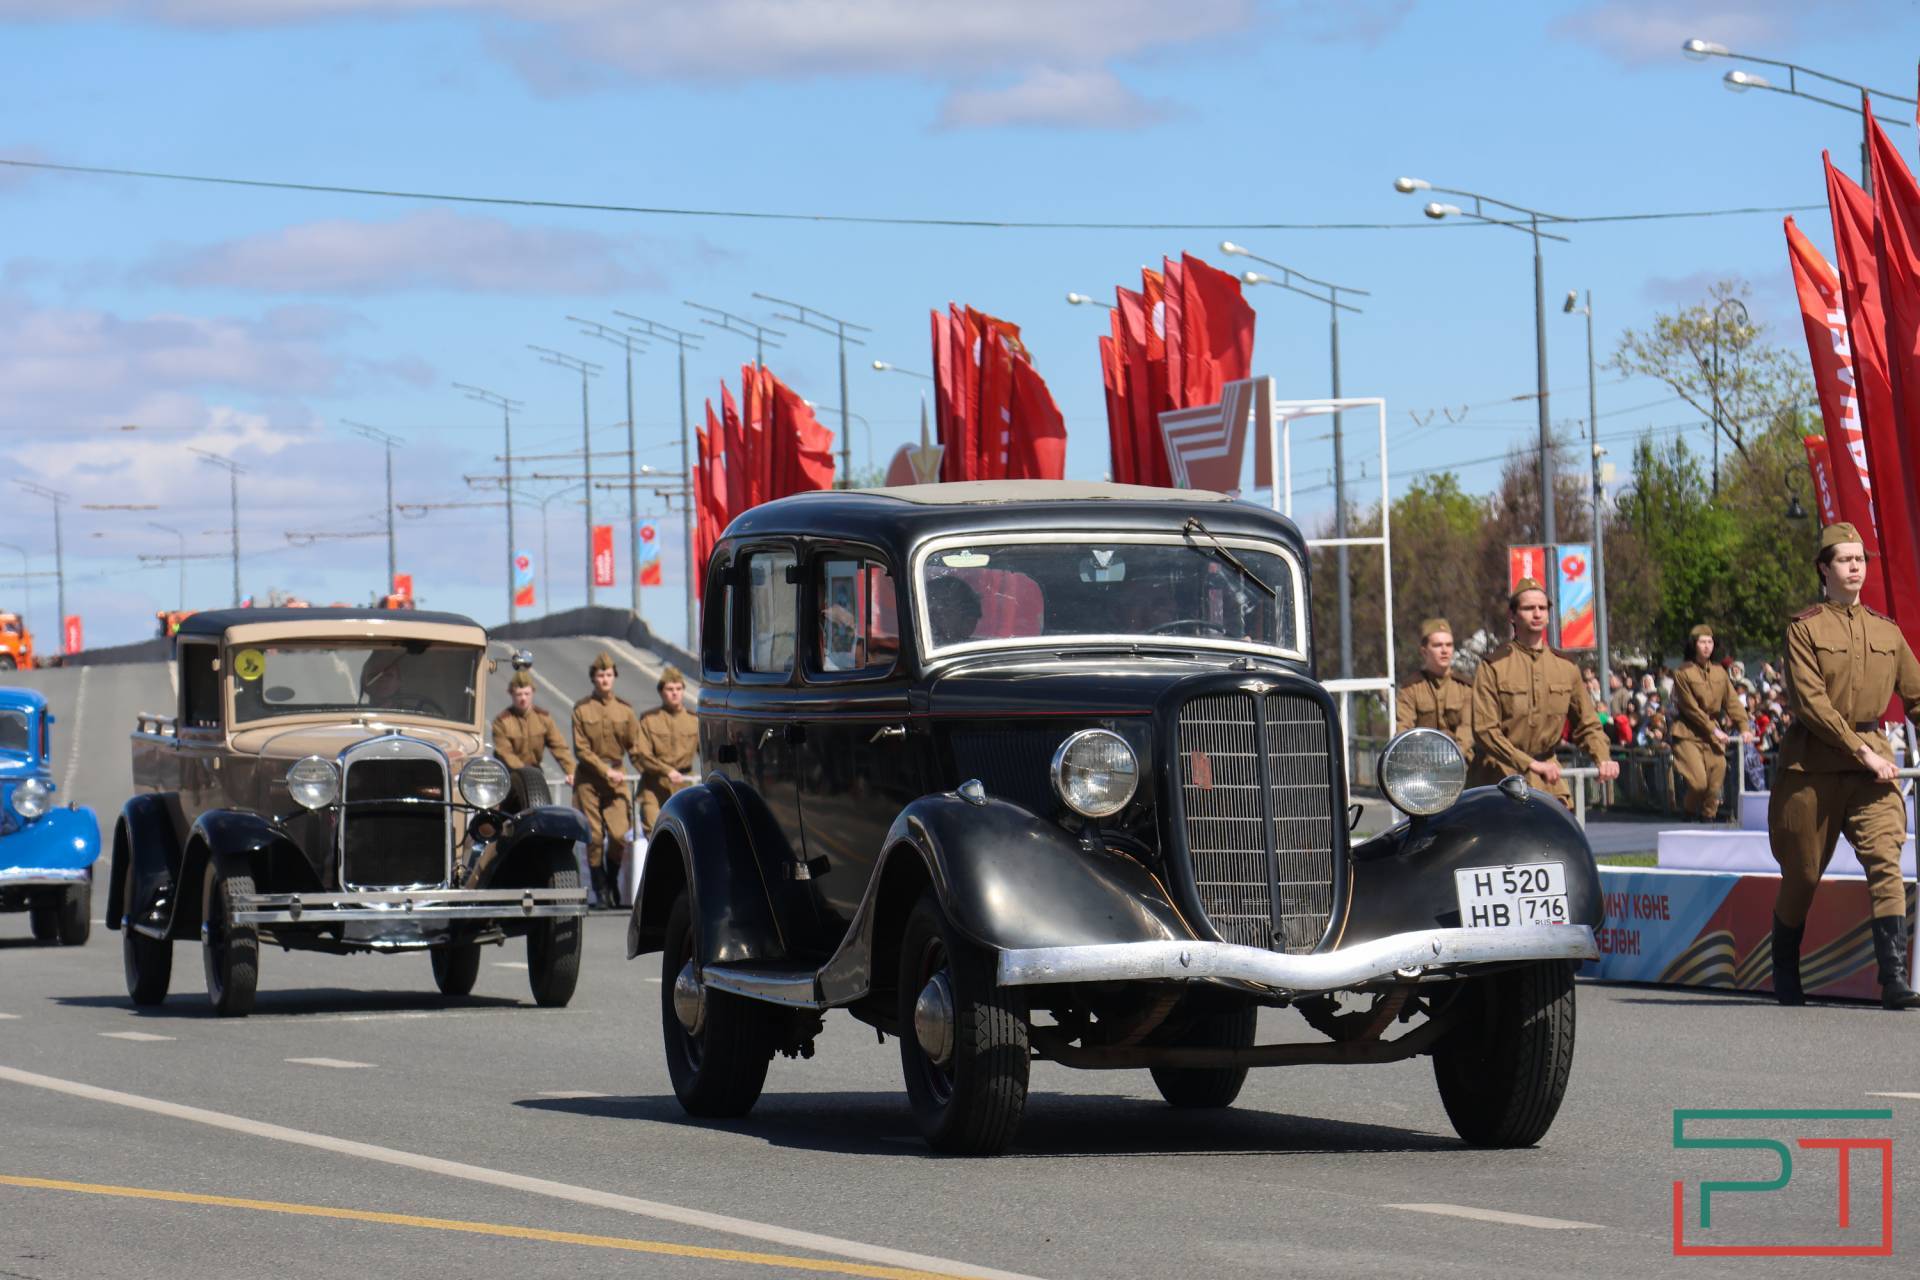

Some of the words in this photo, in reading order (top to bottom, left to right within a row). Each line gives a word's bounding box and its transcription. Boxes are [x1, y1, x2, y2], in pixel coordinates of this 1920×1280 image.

[1474, 872, 1493, 897] Н
[1502, 868, 1550, 894] 520
[1472, 904, 1511, 928] НВ
[1526, 898, 1564, 919] 716
